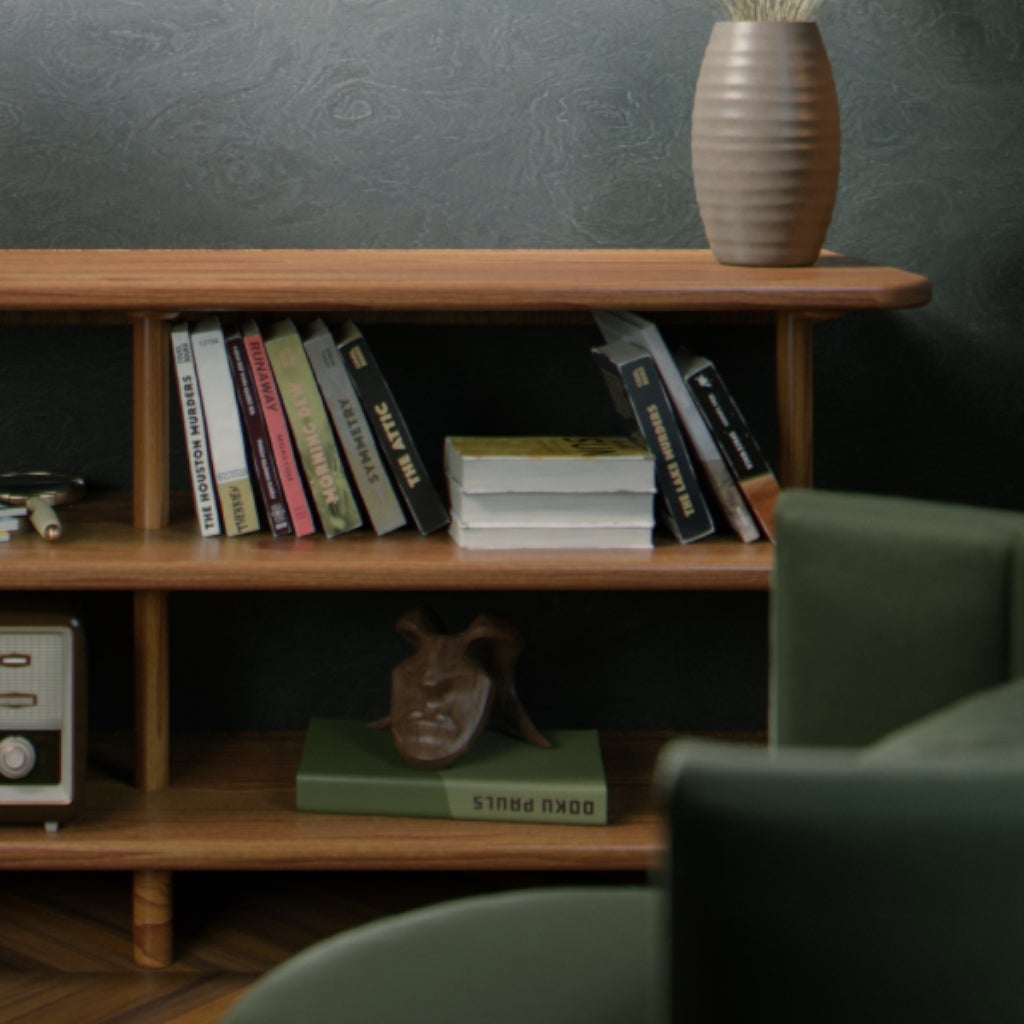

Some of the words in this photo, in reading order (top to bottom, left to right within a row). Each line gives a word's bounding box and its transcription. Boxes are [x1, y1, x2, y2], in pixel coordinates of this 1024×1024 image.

[249, 341, 278, 413] RUNAWAY
[182, 375, 201, 437] MURDERS
[288, 382, 310, 419] DEW
[338, 398, 381, 485] SYMMETRY
[374, 401, 406, 451] ATTIC
[645, 404, 678, 461] MURDERS
[191, 440, 211, 502] HOUSTON
[300, 422, 340, 505] MORNING
[397, 456, 422, 489] THE
[666, 461, 688, 494] LAKE
[199, 506, 215, 530] THE
[679, 492, 696, 518] THE
[473, 795, 535, 813] PAULS
[541, 797, 595, 815] DOKU
